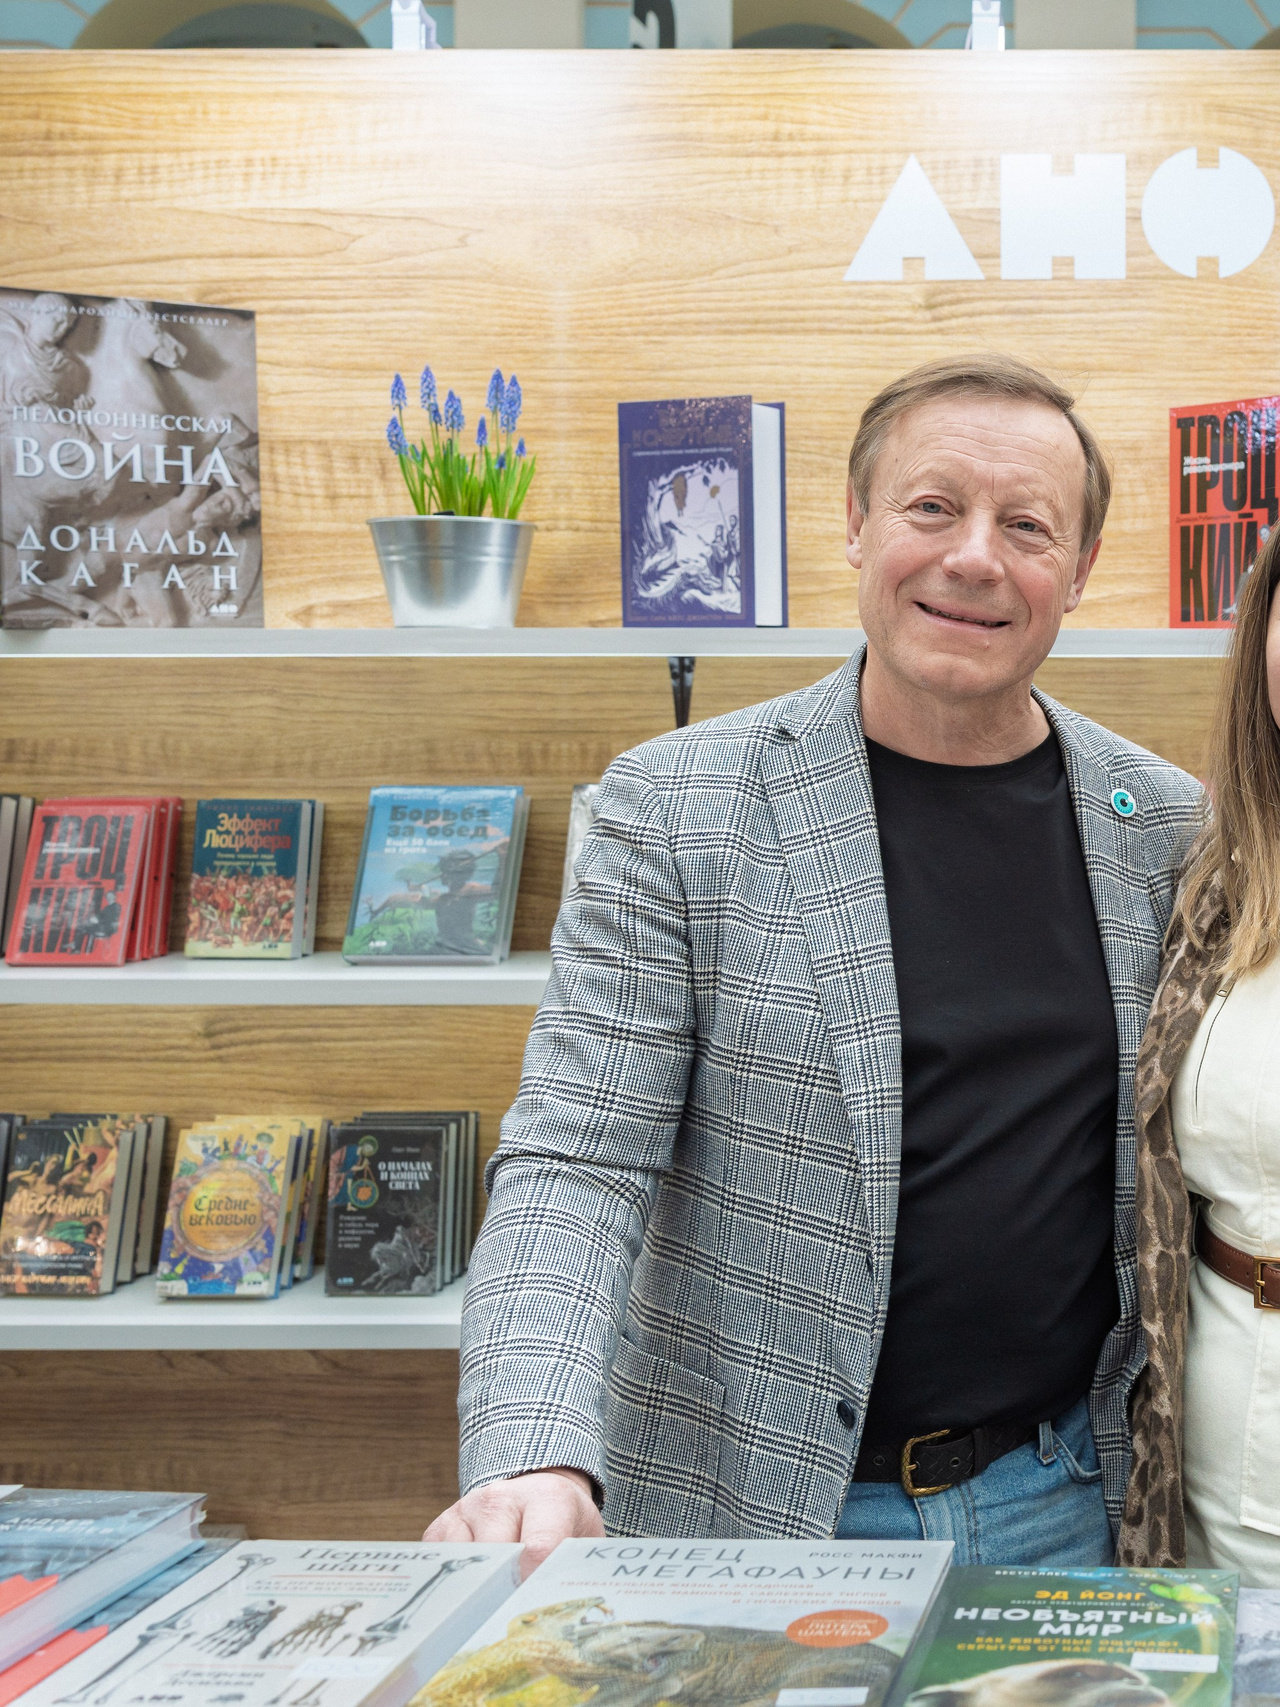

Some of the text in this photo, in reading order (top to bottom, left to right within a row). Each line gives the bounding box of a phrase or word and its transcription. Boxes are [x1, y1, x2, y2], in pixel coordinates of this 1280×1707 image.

[12, 406, 233, 434] ПЕЛОПОННЕССКАЯ
[13, 432, 240, 487] ВОЙНА
[17, 524, 240, 557] ДОНАЛЬД
[20, 560, 239, 591] КАГАН
[390, 805, 491, 823] Борьба
[217, 812, 282, 836] Эффект
[386, 822, 489, 839] за обед
[203, 829, 291, 853] Люцифера
[378, 1161, 432, 1171] О НАЧАЛАХ
[389, 1171, 430, 1181] КОНЦАХ
[389, 1181, 420, 1190] СВЕТА
[194, 1196, 255, 1212] Средне-
[189, 1213, 257, 1227] вековью
[297, 1548, 440, 1565] Первые
[585, 1547, 746, 1563] КОНЕЦ
[306, 1562, 402, 1573] шаги
[612, 1564, 916, 1580] МЕГАФАУНЫ
[1035, 1588, 1147, 1601] ЭД ЙОНГ
[953, 1607, 1214, 1626] НЕОБЪЯТНЫЙ
[1038, 1622, 1124, 1637] МИР
[957, 1643, 1030, 1652] СКРЫТУЮ
[1036, 1644, 1056, 1652] ОТ
[1062, 1644, 1091, 1653] НАС
[975, 1636, 1179, 1648] КАК ЖИВОТНЫЕ ОЩУЩАЮТ
